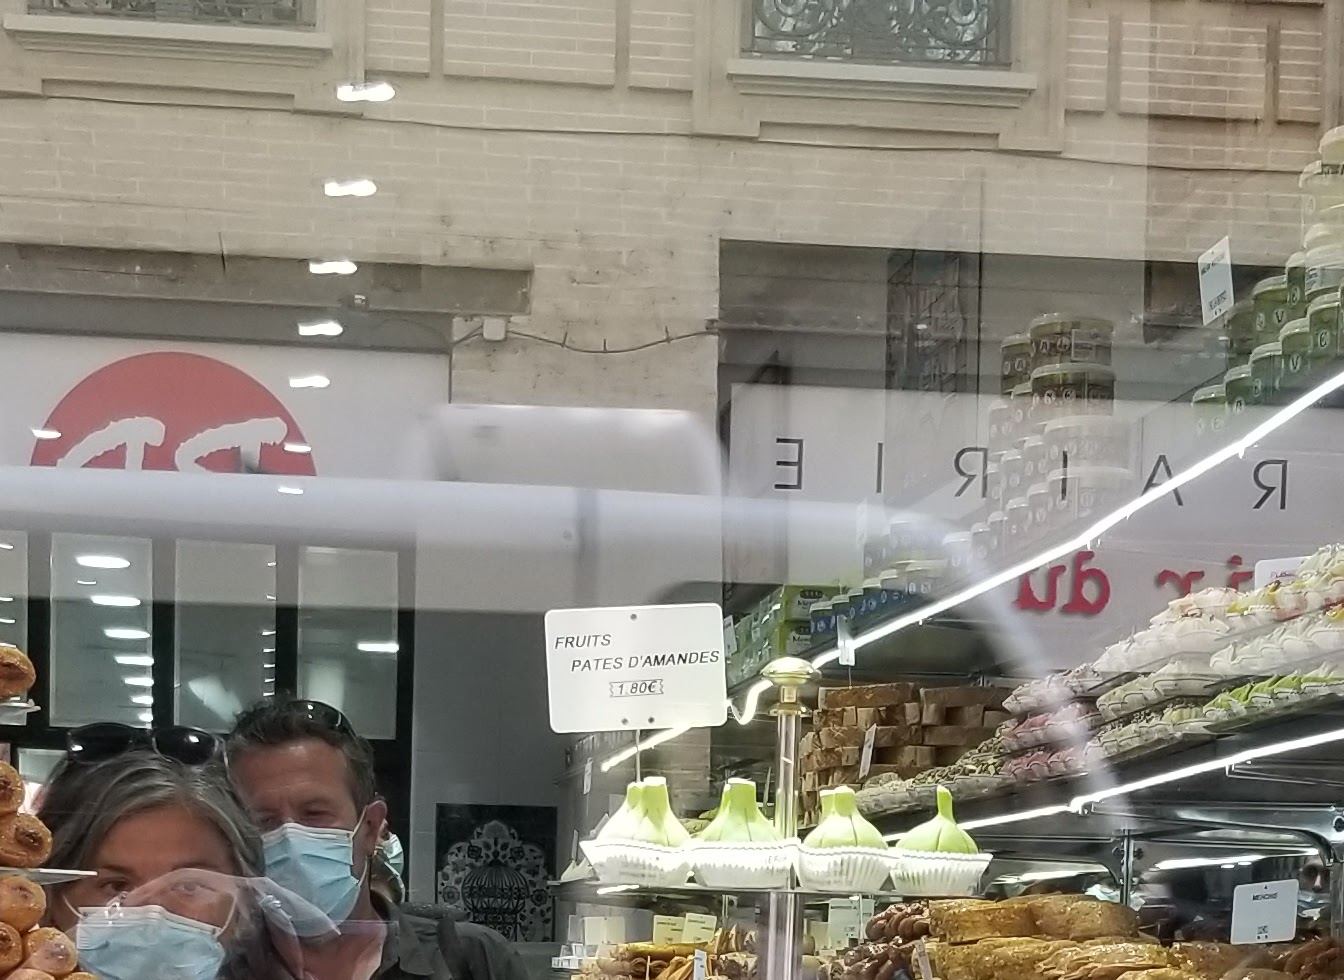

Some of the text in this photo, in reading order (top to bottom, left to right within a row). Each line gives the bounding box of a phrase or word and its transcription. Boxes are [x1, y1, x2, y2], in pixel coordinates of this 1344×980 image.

[554, 634, 612, 650] FRUITS
[571, 650, 720, 672] PATES D'AMANDES
